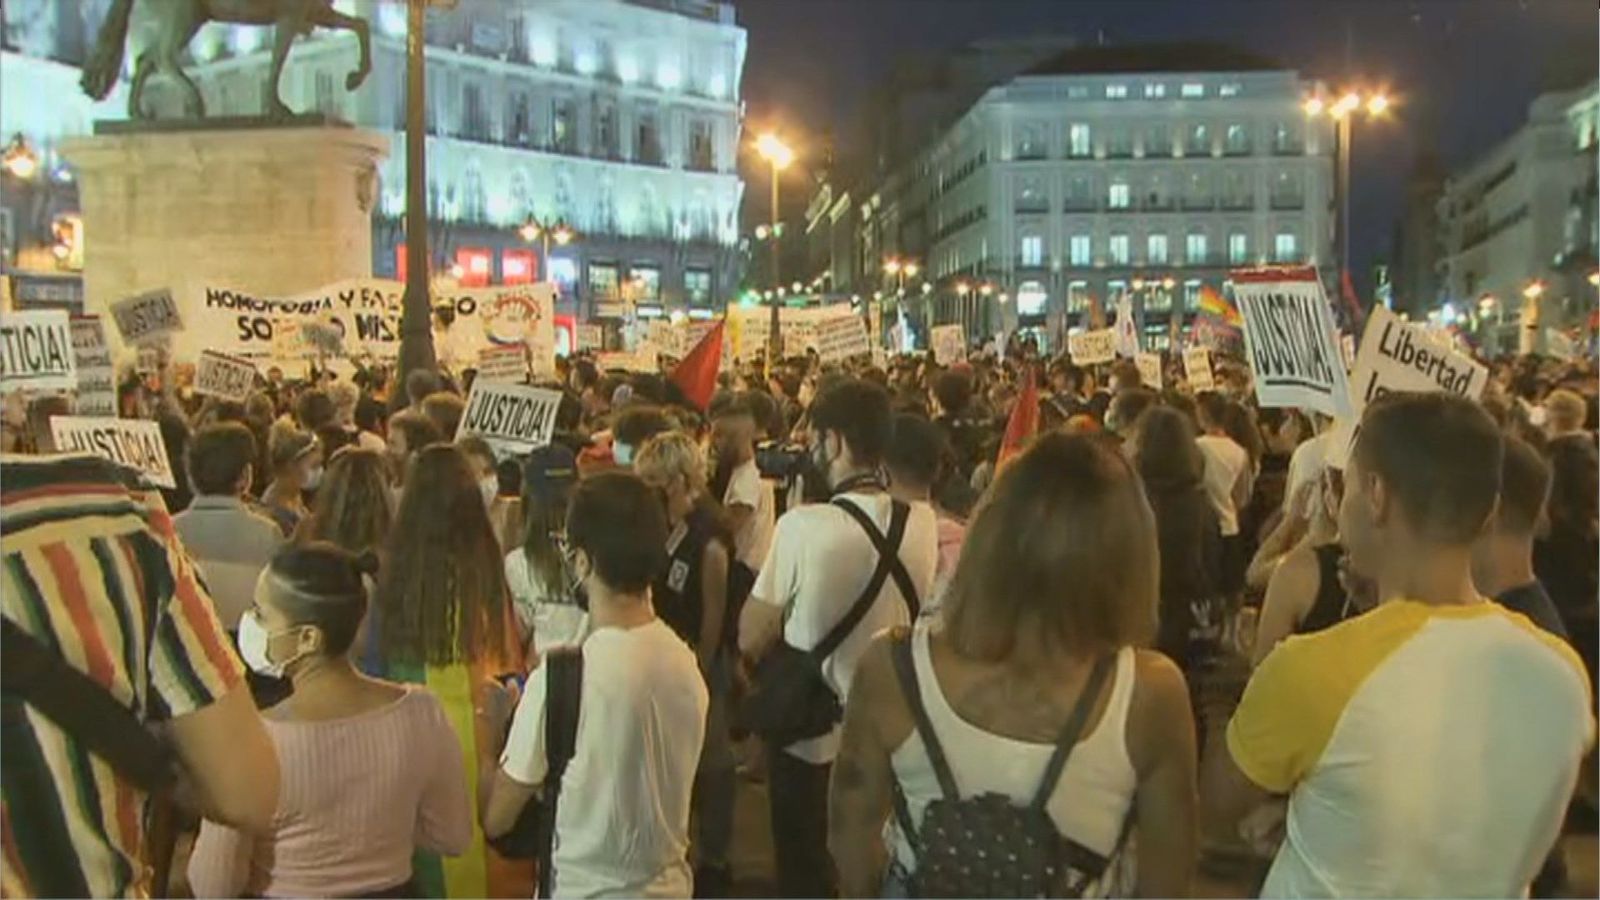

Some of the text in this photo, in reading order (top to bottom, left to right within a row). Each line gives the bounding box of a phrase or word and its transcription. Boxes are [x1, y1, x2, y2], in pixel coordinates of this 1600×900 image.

[338, 289, 354, 308] Y
[237, 315, 278, 342] SO
[0, 325, 71, 371] TICIA!
[1378, 321, 1475, 398] Libertad
